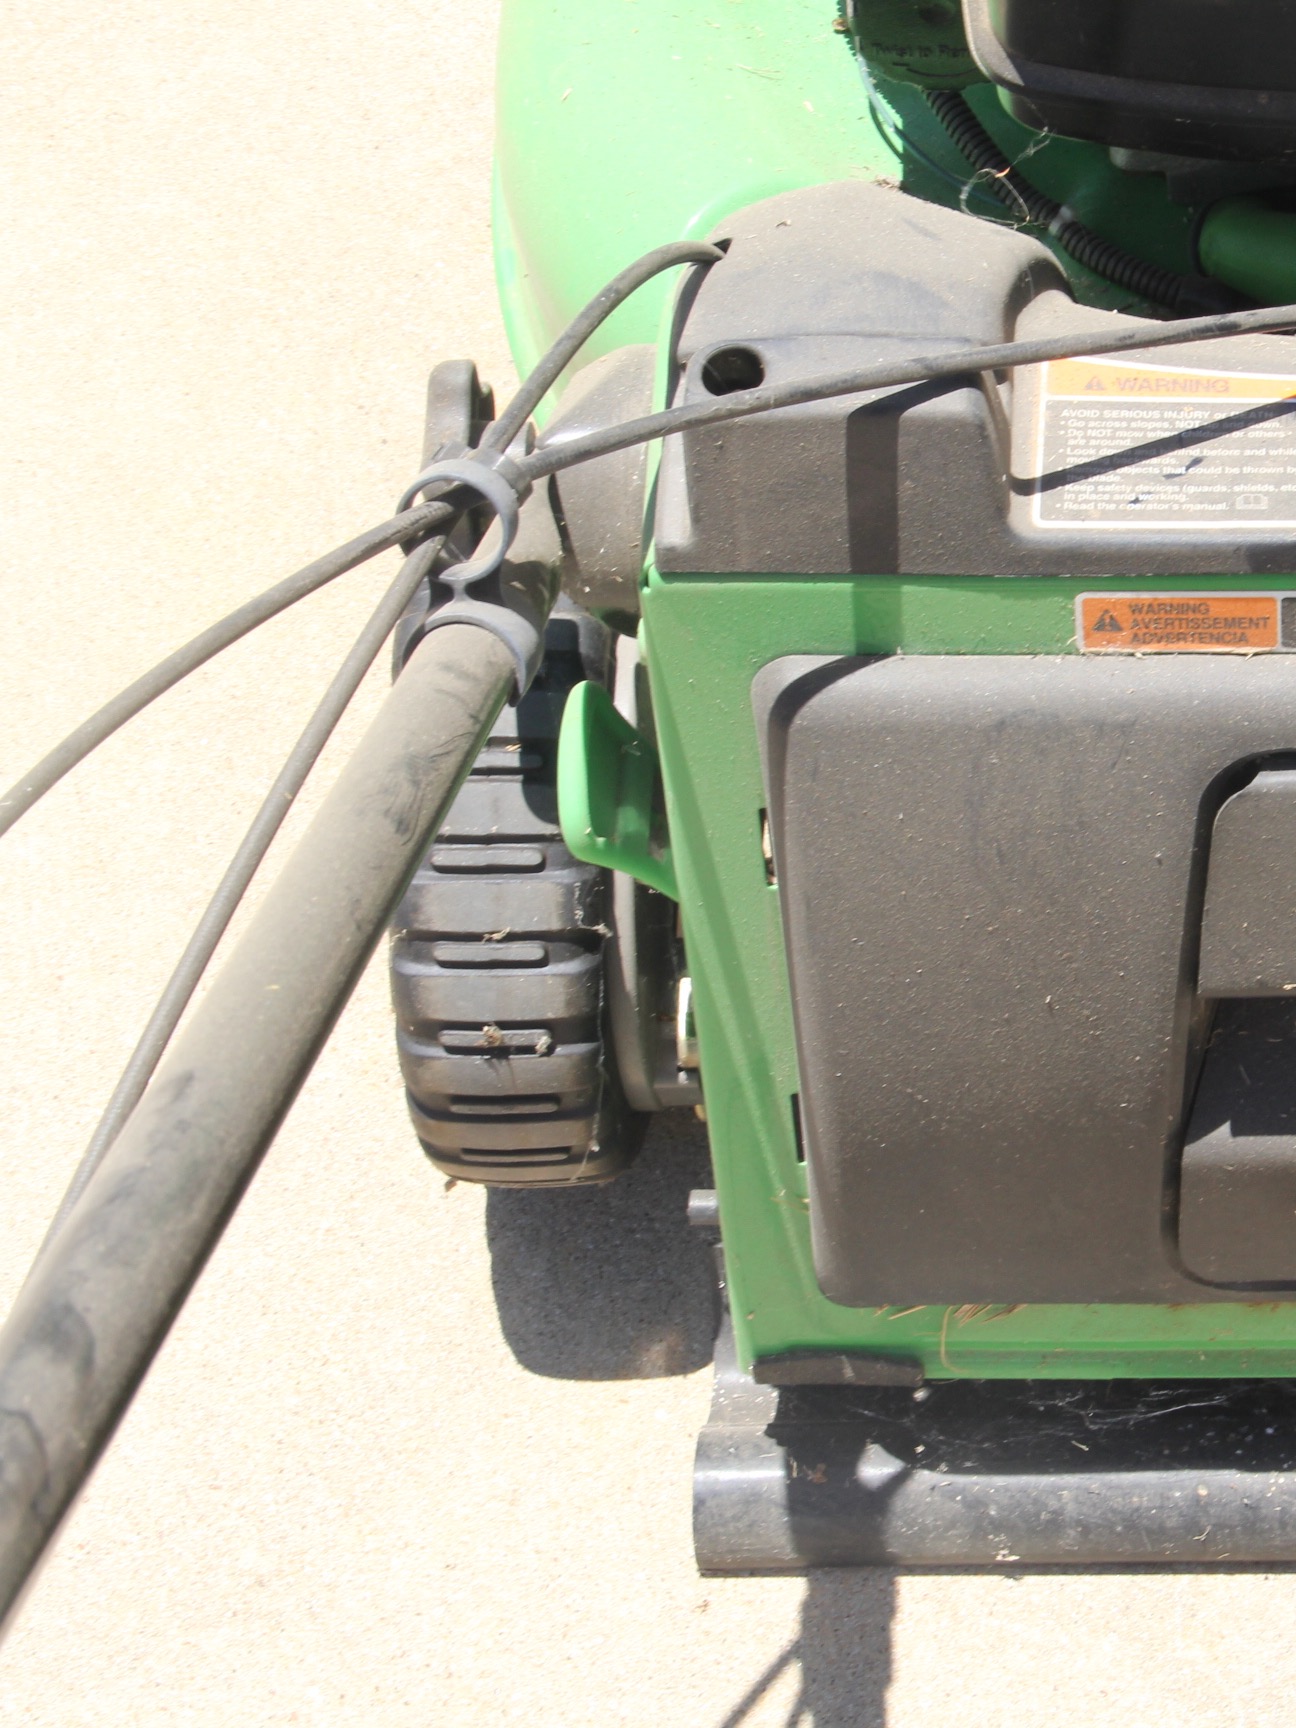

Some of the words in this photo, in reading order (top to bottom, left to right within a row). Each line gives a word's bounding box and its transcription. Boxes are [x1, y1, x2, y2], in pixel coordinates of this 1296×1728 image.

[1116, 379, 1229, 393] WARNING
[1061, 409, 1100, 418] AVOID
[1103, 410, 1161, 419] SERIOUS
[1163, 410, 1210, 420] INJURY
[1214, 412, 1229, 420] or
[1067, 419, 1086, 428] Go
[1087, 421, 1129, 429] across
[1130, 420, 1174, 430] slopes,
[1175, 421, 1202, 429] NOT
[1067, 429, 1086, 438] Do
[1087, 429, 1114, 438] NOT
[1115, 430, 1144, 438] mow
[1146, 430, 1178, 438] when
[1180, 430, 1228, 439] children
[1231, 431, 1244, 439] or
[1247, 430, 1286, 438] others
[1066, 439, 1087, 447] are
[1089, 438, 1134, 447] around.
[1066, 447, 1097, 456] Look
[1099, 447, 1131, 456] down
[1160, 448, 1201, 457] behind
[1203, 447, 1241, 457] before
[1243, 447, 1266, 456] and
[1115, 466, 1160, 477] objects
[1161, 466, 1186, 475] that
[1188, 466, 1222, 475] could
[1224, 466, 1241, 475] be
[1243, 466, 1285, 475] thrown
[1064, 484, 1095, 494] Keep
[1096, 484, 1133, 494] safety
[1134, 484, 1180, 493] devices
[1233, 483, 1279, 493] shields,
[1064, 492, 1076, 501] in
[1077, 492, 1111, 502] place
[1112, 492, 1136, 501] and
[1138, 492, 1190, 503] working.
[1063, 502, 1095, 511] Read
[1097, 502, 1117, 511] the
[1118, 502, 1180, 511] operator's
[1181, 502, 1230, 511] manual.
[1129, 602, 1211, 616] WARNING
[1130, 616, 1270, 630] AVERTISSEMENT
[1130, 631, 1249, 645] ADVERTENCIA
